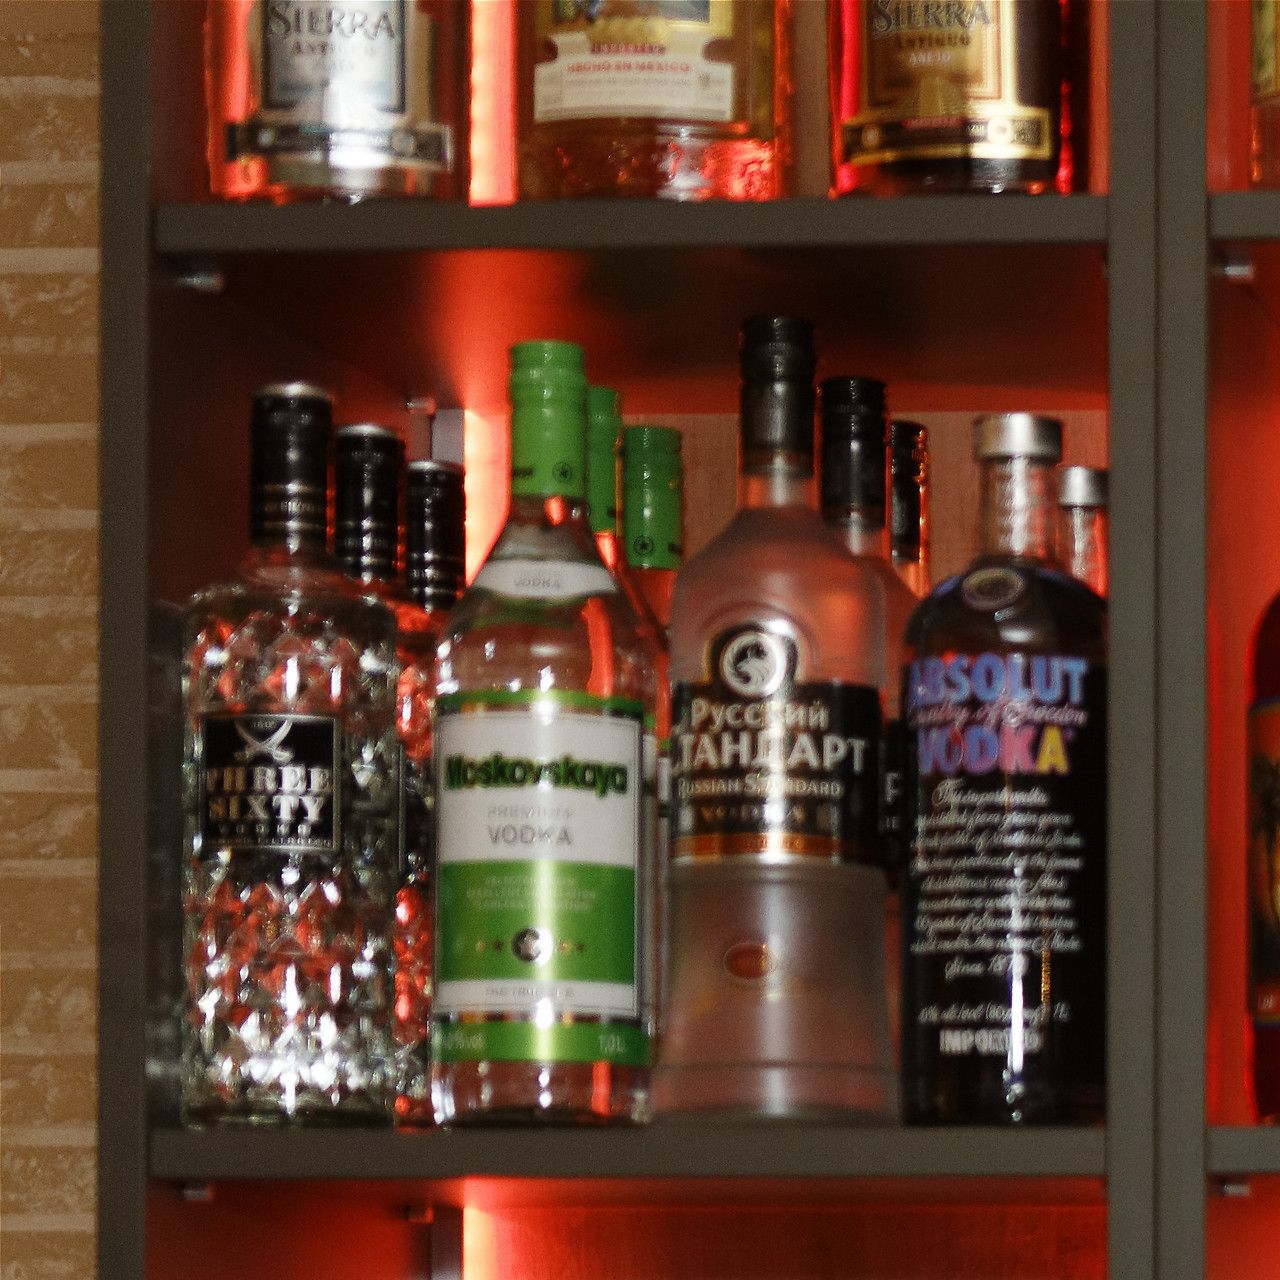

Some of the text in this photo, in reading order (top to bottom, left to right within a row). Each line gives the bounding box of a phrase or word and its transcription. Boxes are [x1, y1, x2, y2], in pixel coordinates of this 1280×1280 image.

[268, 2, 396, 42] SIERRA
[872, 0, 993, 38] SIERRA
[909, 653, 1088, 707] ABSOLUT
[691, 700, 829, 733] Русский
[917, 724, 1072, 785] VODKA
[206, 764, 331, 793] THREE
[209, 795, 325, 823] SIXTY
[487, 823, 573, 846] VODKA
[939, 1030, 1042, 1054] IMPORTD
